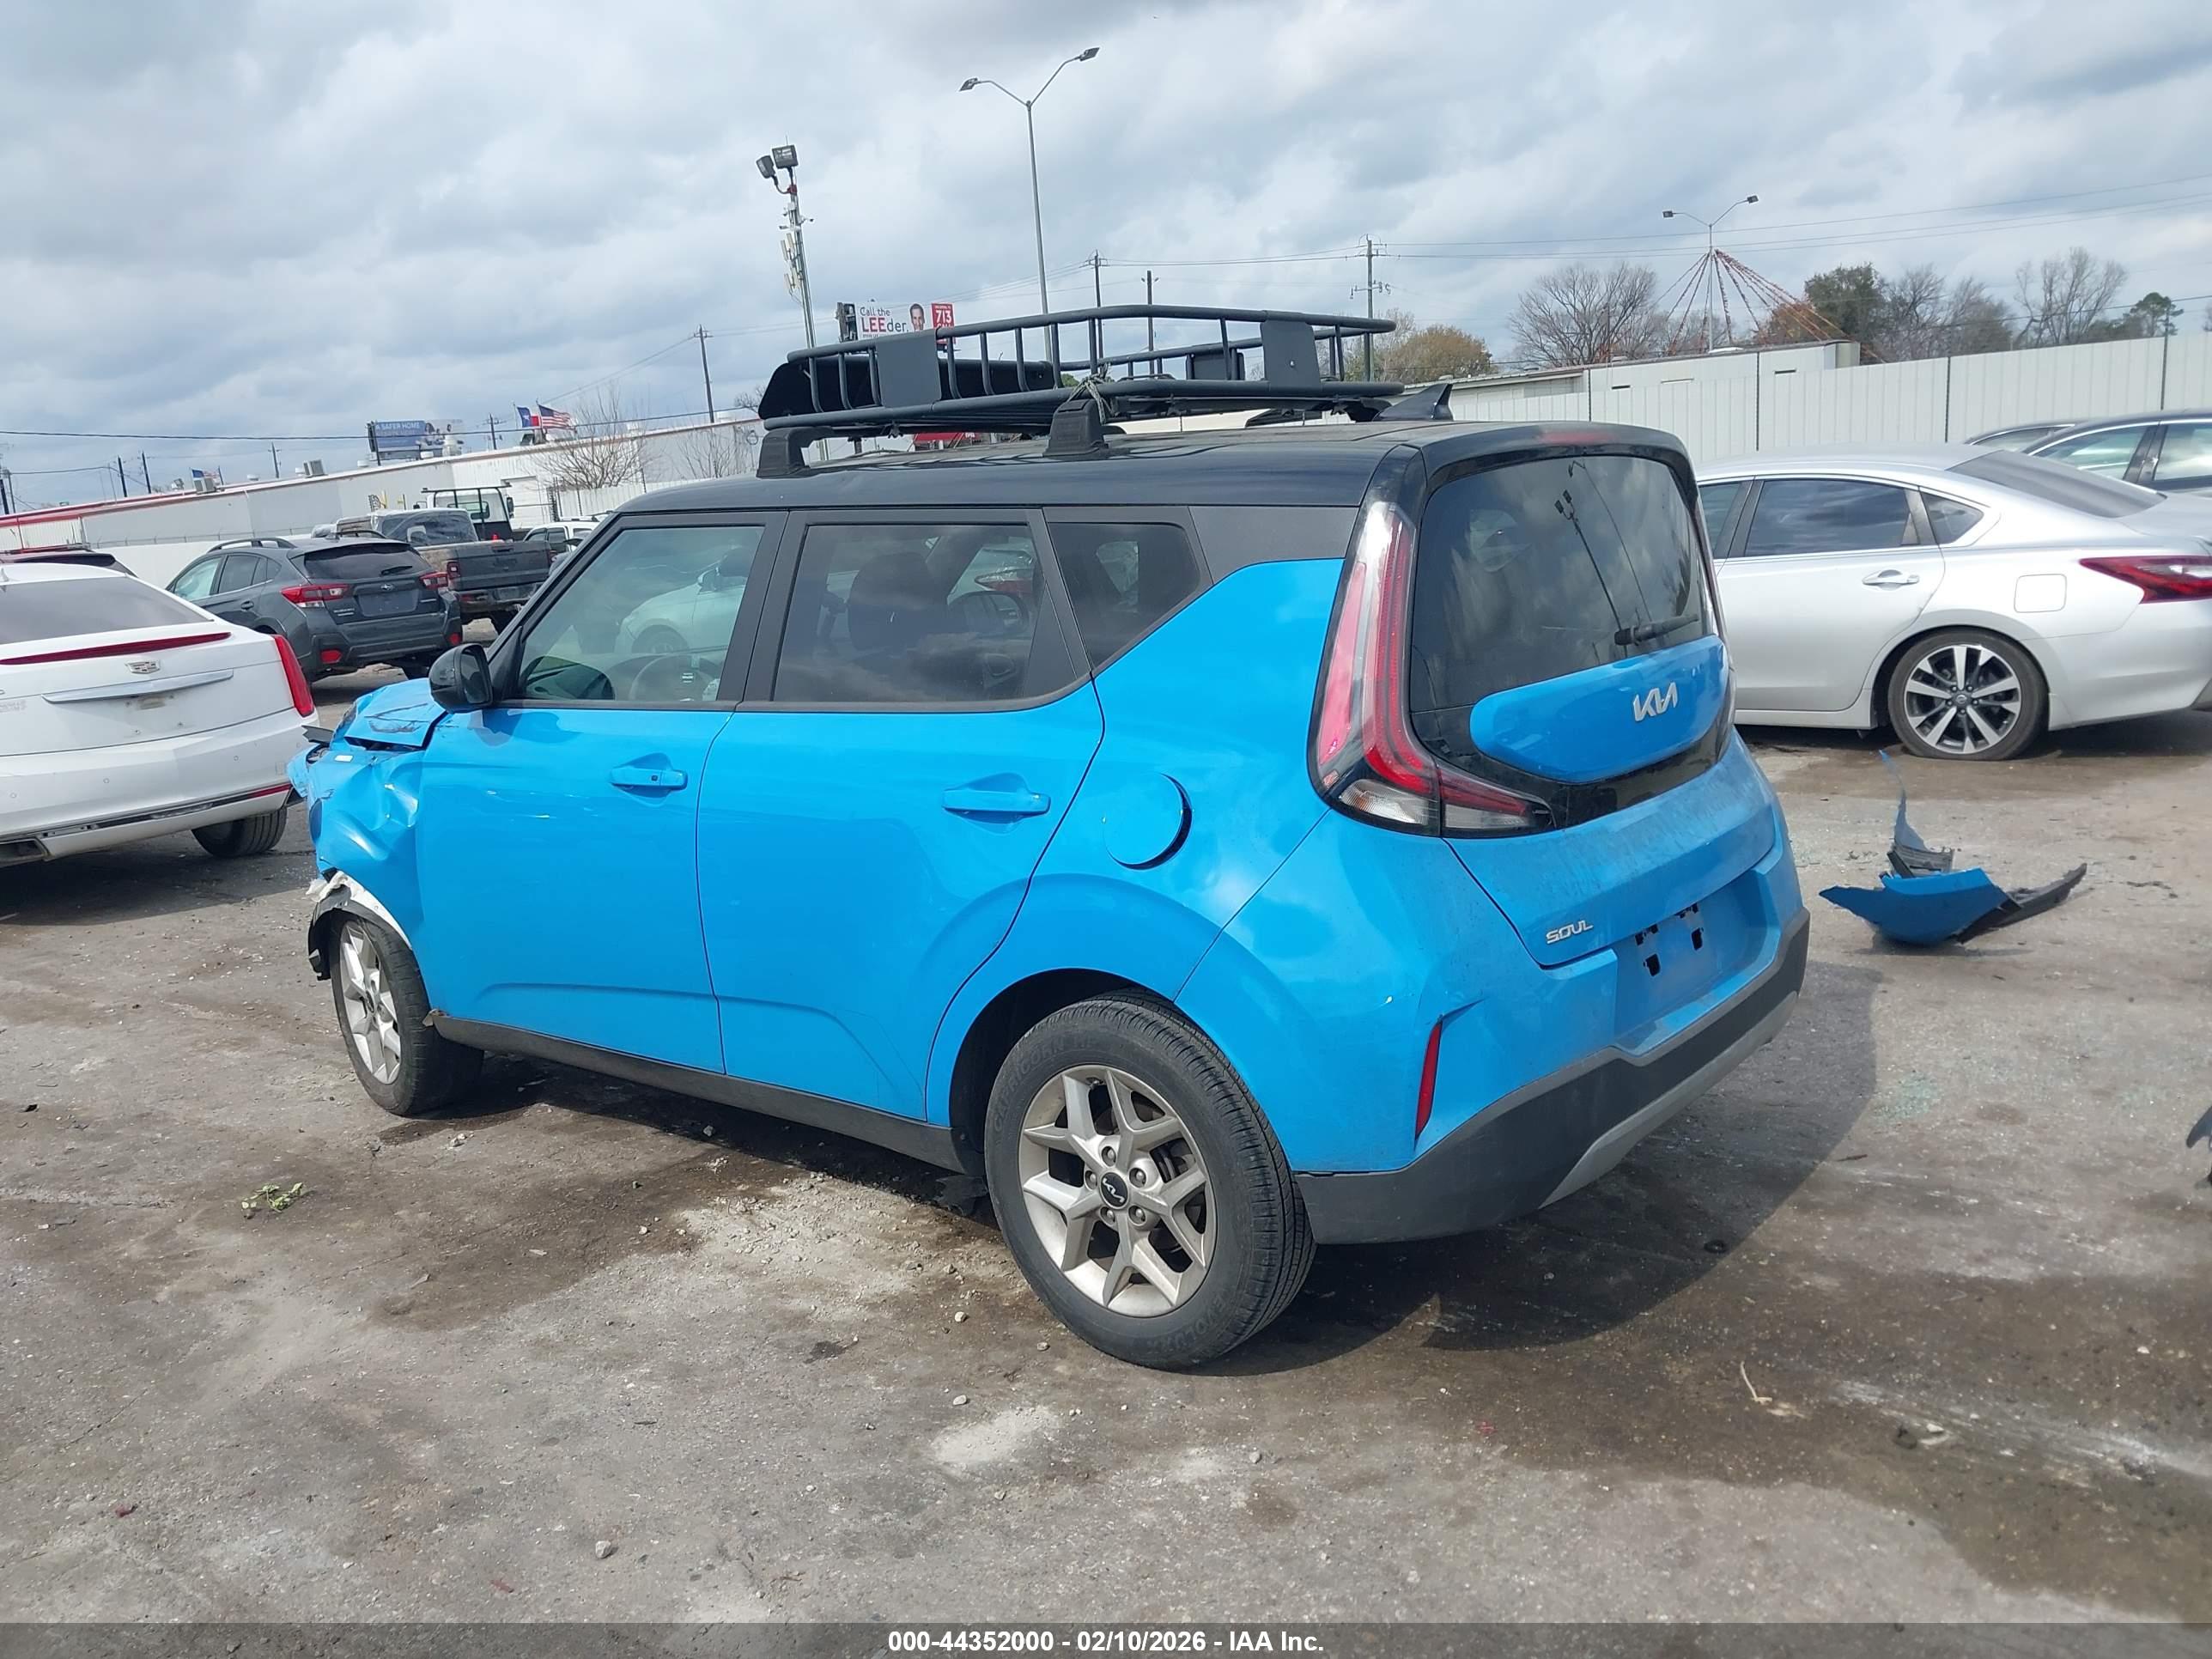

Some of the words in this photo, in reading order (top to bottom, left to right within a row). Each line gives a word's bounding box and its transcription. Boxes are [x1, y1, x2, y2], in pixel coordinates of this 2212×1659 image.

[860, 306, 875, 317] Call
[877, 307, 890, 317] the
[936, 309, 952, 324] 713
[861, 317, 908, 332] LEEder.
[1632, 681, 1678, 721] KIA
[1546, 920, 1594, 945] SOUL
